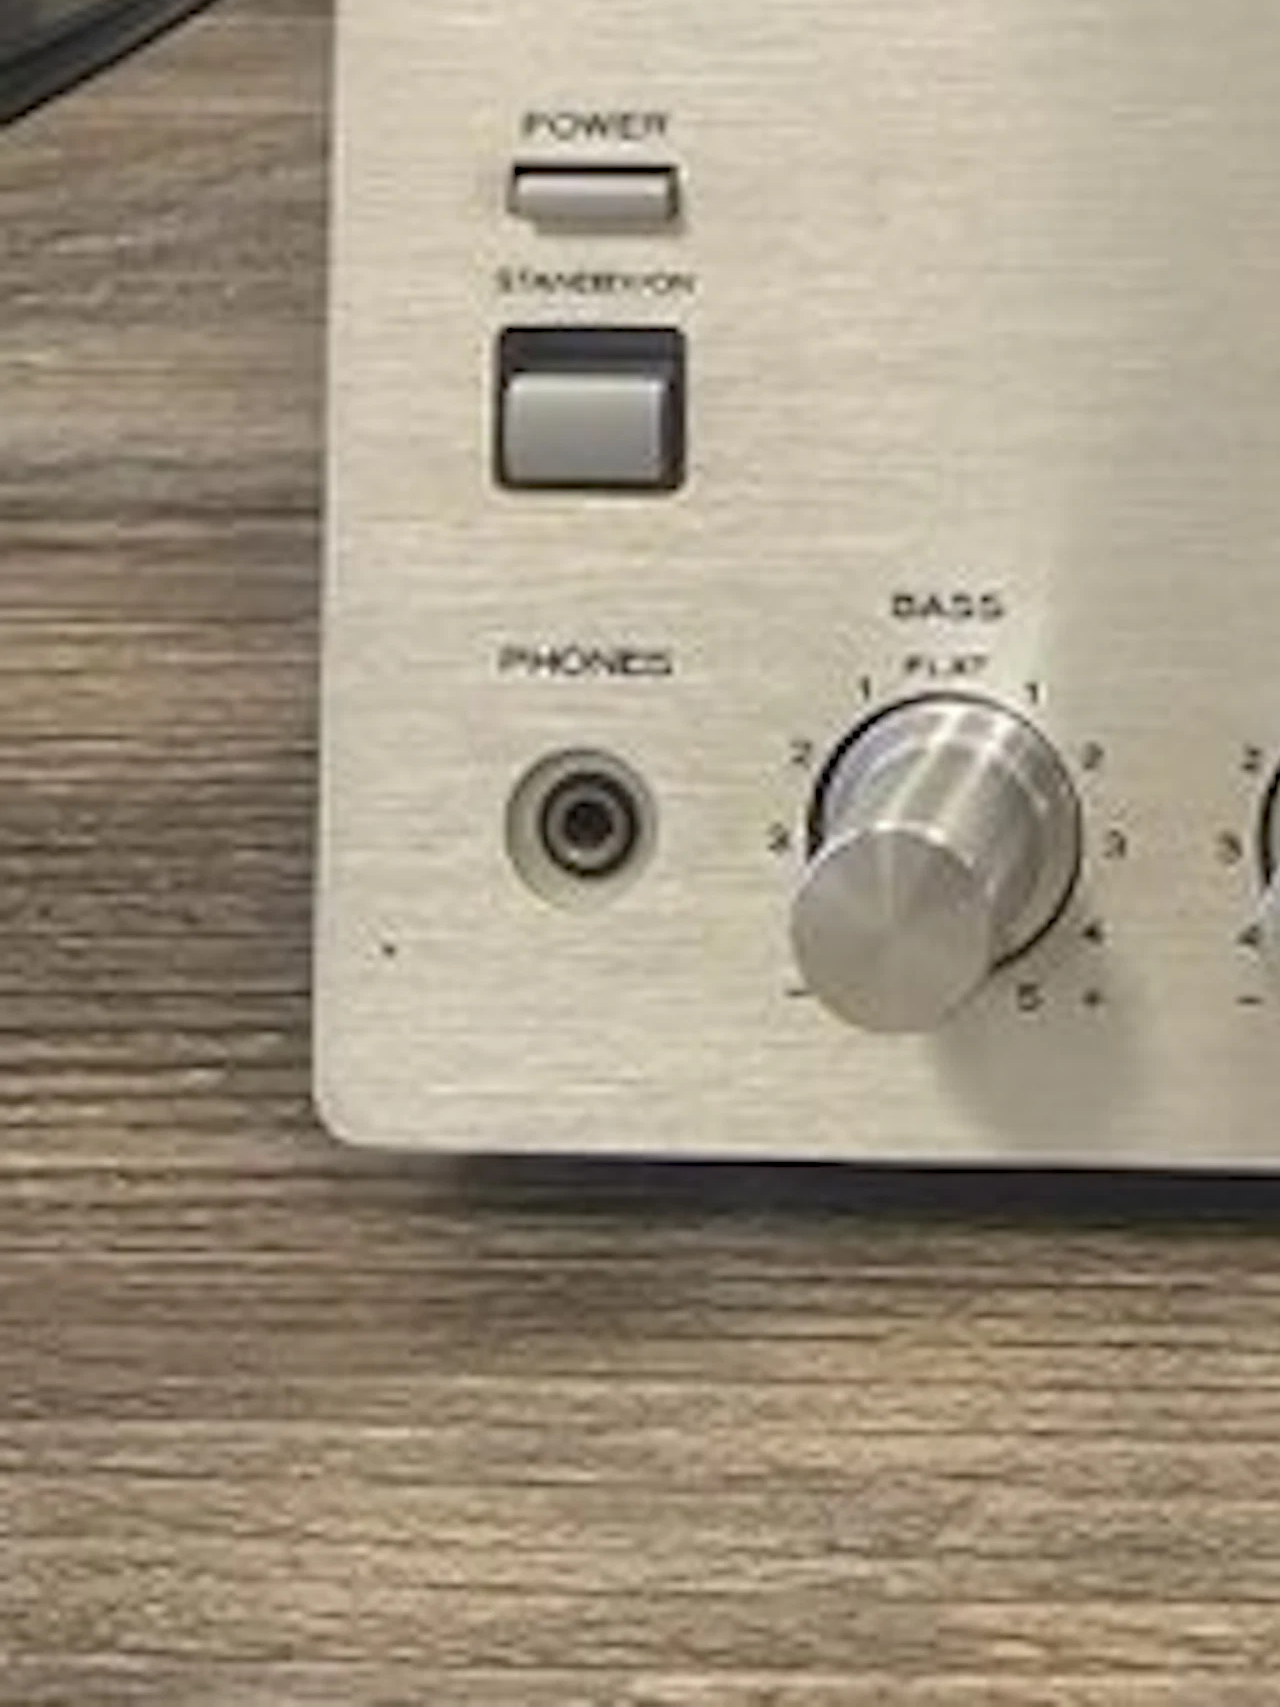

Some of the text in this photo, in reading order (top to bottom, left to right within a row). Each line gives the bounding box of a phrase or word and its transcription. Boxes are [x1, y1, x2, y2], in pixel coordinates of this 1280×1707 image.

[522, 109, 670, 139] POWER
[891, 593, 1004, 621] BASS
[500, 646, 673, 678] PHONES
[905, 655, 990, 675] FLAT
